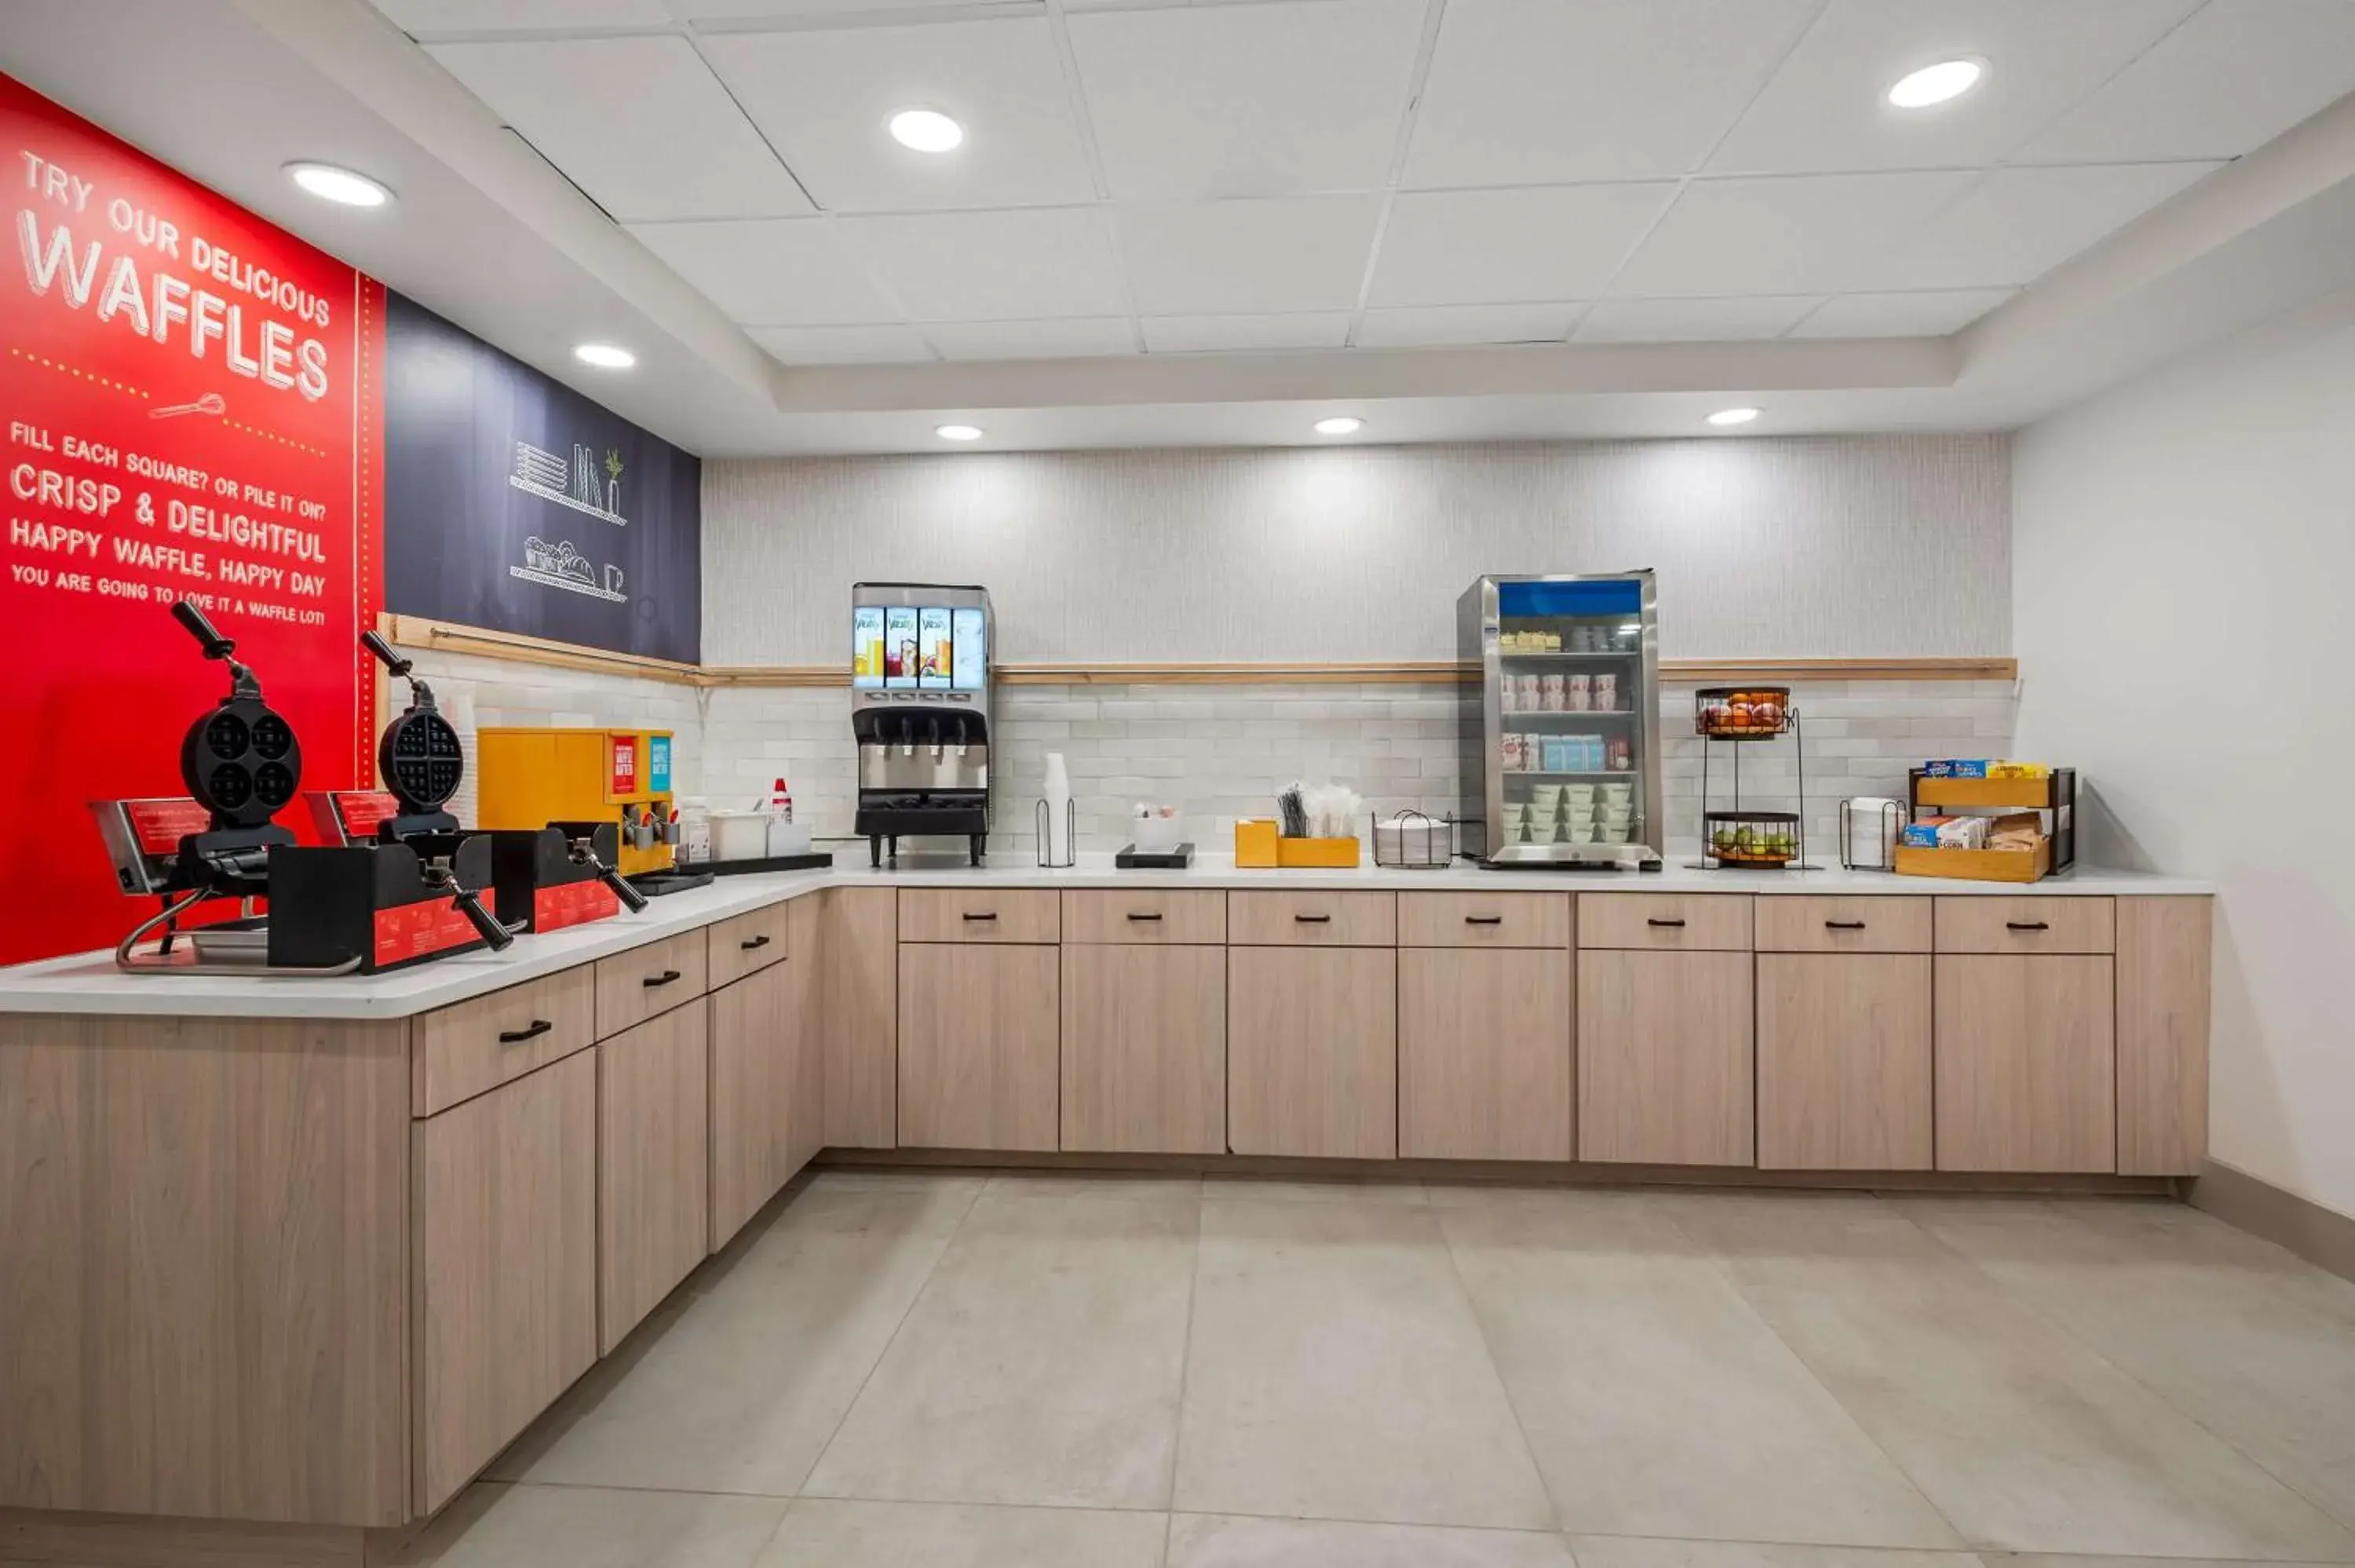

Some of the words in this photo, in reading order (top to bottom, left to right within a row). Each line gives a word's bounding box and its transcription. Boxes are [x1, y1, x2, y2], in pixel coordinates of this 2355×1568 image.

[22, 151, 93, 212] TRY
[109, 198, 179, 260] OUR
[192, 237, 330, 328] DELICIOUS
[17, 209, 328, 402] WAFFLES
[11, 421, 55, 452] FILL
[63, 436, 118, 469] EACH
[126, 453, 208, 490] SQUARE?
[214, 477, 239, 499] OR
[244, 484, 276, 509] PILE
[281, 494, 294, 513] IT
[299, 500, 326, 521] ON?
[11, 464, 121, 519] CRISP
[136, 492, 155, 527] &
[168, 499, 326, 563] DELIGHTFUL
[11, 518, 102, 559] HAPPY
[113, 537, 212, 581] WAFFLE,
[220, 559, 283, 589] HAPPY
[290, 571, 325, 597] DAY
[12, 564, 49, 587] YOU
[56, 572, 92, 593] ARE
[97, 578, 148, 600] GOING
[154, 586, 173, 603] TO
[218, 597, 231, 612] IT
[236, 600, 244, 614] A
[249, 601, 296, 622] WAFFLE
